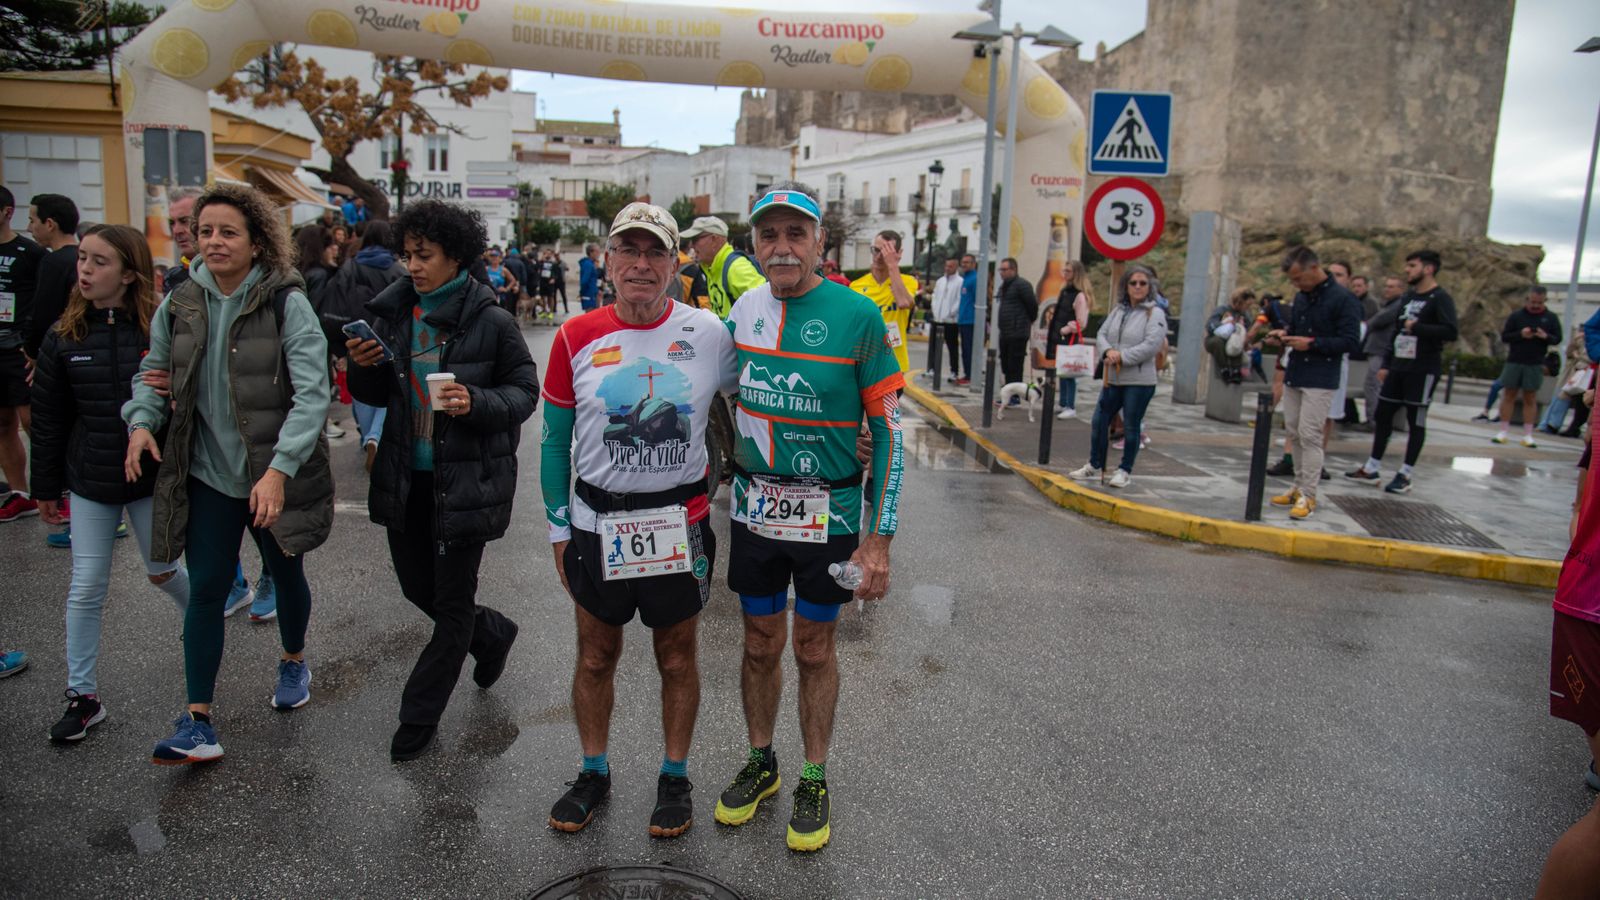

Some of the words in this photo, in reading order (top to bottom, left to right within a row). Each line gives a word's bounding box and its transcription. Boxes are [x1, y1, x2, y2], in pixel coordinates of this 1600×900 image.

[354, 5, 421, 32] Radler
[513, 4, 541, 22] CON
[546, 7, 585, 28] ZUMO
[591, 14, 649, 33] NATURAL
[656, 18, 673, 35] DE
[757, 17, 885, 42] Cruzcampo
[512, 24, 613, 53] DOBLEMENTE
[617, 35, 720, 60] REFRESCANTE
[770, 44, 832, 68] Radler
[740, 386, 785, 409] RAFRICA
[788, 396, 823, 413] TRAIL
[783, 431, 826, 443] dinan
[891, 430, 901, 469] EURAFRICA
[607, 440, 635, 465] Vive
[638, 440, 652, 466] la
[656, 438, 686, 466] vida
[760, 484, 785, 497] XIV
[886, 471, 899, 490] TRAIL
[764, 497, 807, 521] 294
[879, 493, 894, 530] EURAFRICA
[615, 522, 640, 535] XIV
[641, 519, 667, 527] CARRERA
[653, 523, 682, 532] ESTRECHO
[630, 532, 657, 557] 61
